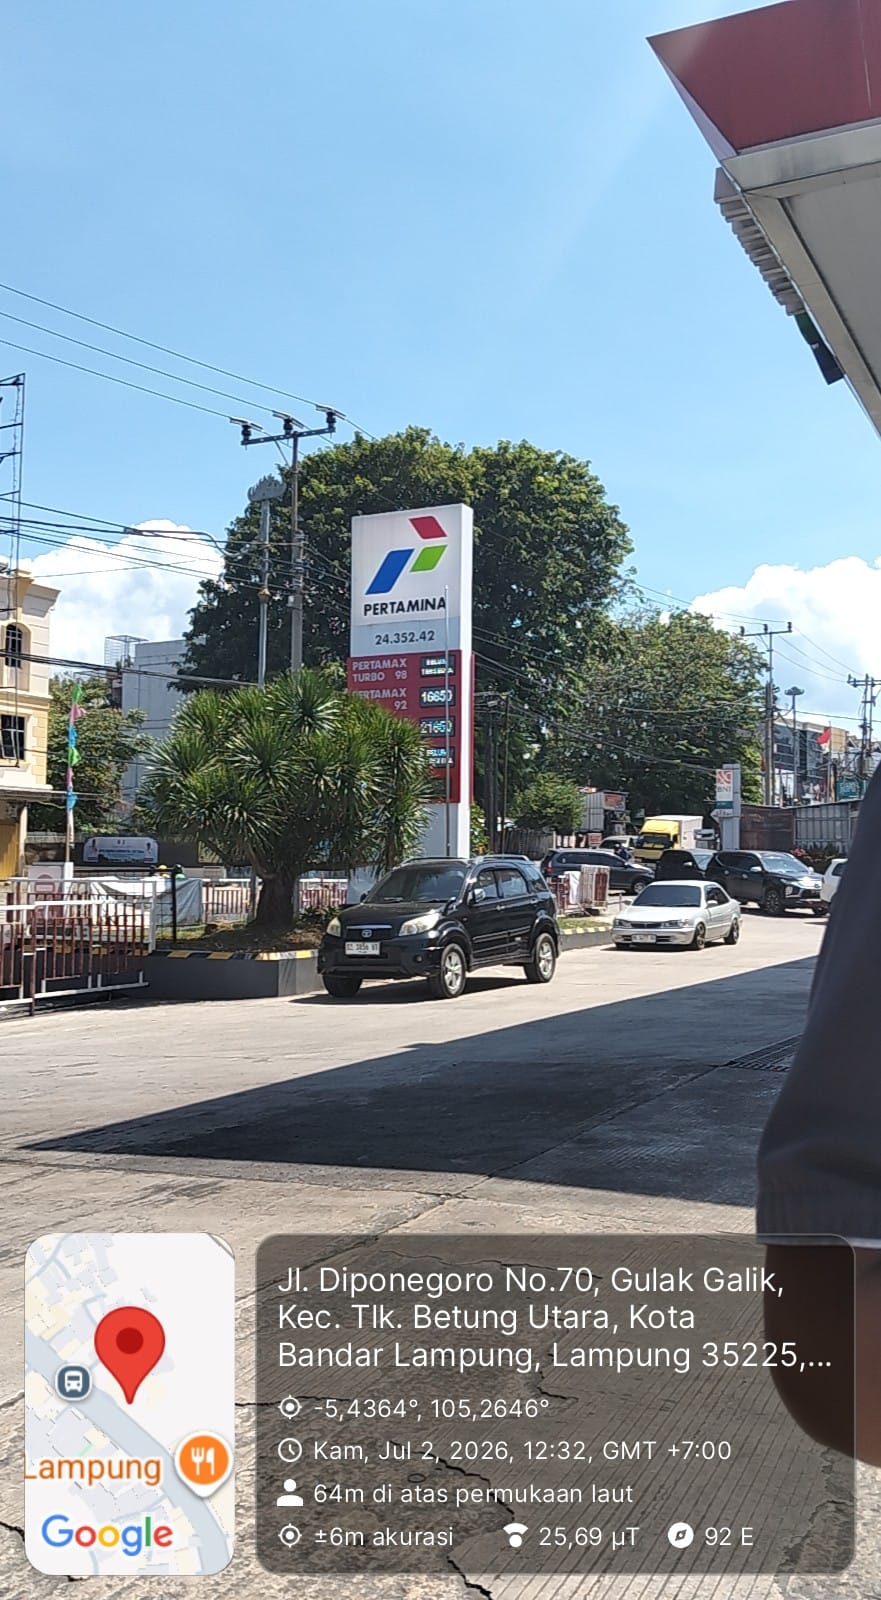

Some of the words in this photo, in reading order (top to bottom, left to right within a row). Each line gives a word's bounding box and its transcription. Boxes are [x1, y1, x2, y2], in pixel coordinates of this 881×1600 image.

[364, 597, 446, 616] PERTAMINA
[375, 630, 435, 645] 24.352.42
[352, 658, 407, 671] PERTAMAX
[352, 672, 385, 682] TURBO
[394, 670, 408, 680] 98
[394, 700, 408, 710] 92
